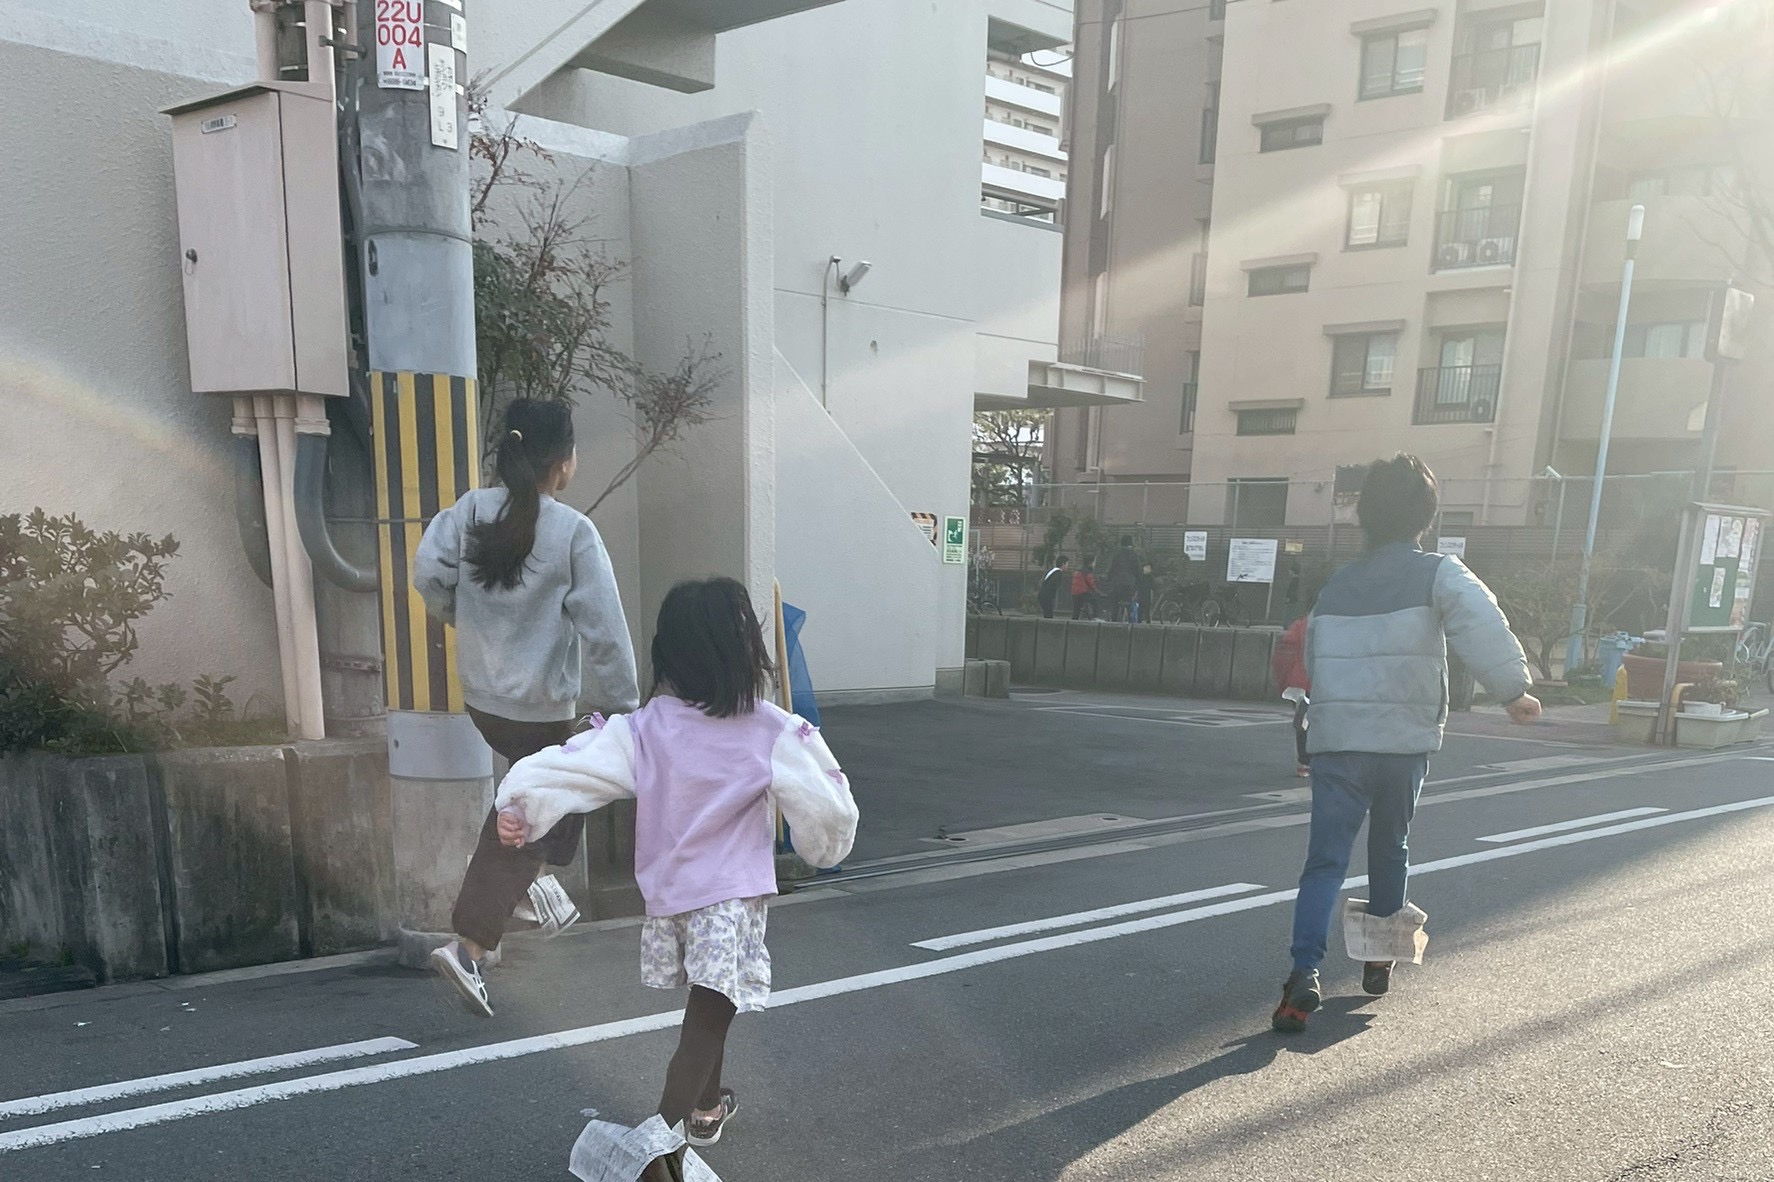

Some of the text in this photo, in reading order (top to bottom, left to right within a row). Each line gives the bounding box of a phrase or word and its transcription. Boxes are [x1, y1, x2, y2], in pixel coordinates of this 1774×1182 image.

[377, 1, 421, 23] 22U
[378, 24, 422, 47] 004
[392, 48, 406, 69] A
